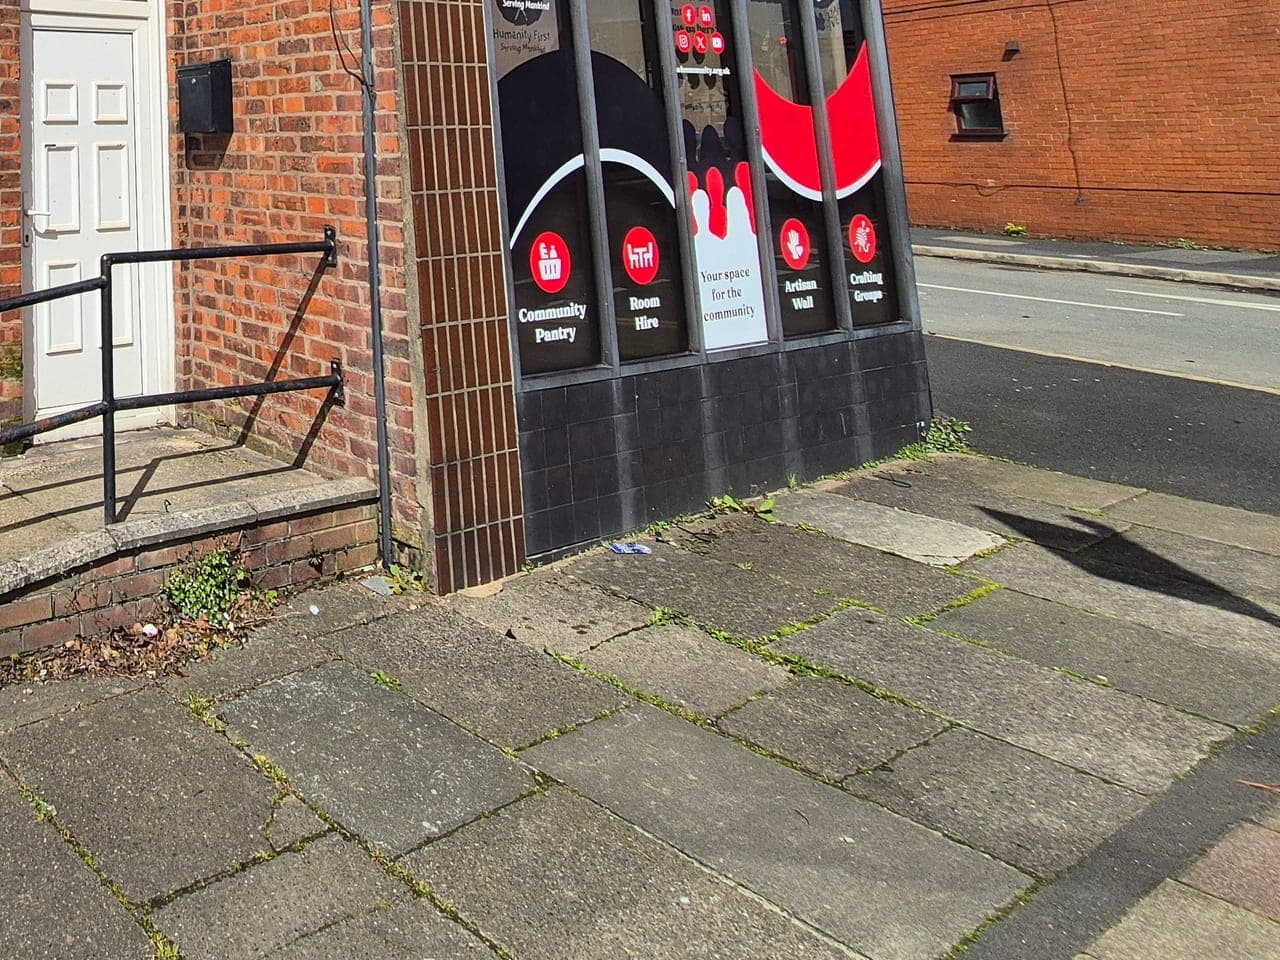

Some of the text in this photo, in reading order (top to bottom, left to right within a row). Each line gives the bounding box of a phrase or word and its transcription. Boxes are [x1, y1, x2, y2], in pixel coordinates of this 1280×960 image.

[502, 0, 524, 10] Serving
[700, 268, 750, 283] Your space
[850, 271, 883, 286] Crafting
[785, 278, 817, 293] Artisan
[711, 287, 742, 301] for the
[629, 296, 661, 311] Room
[791, 296, 814, 311] Wall
[519, 302, 586, 323] Community
[704, 304, 755, 322] community
[634, 315, 659, 331] Hire
[535, 326, 576, 344] Pantry
